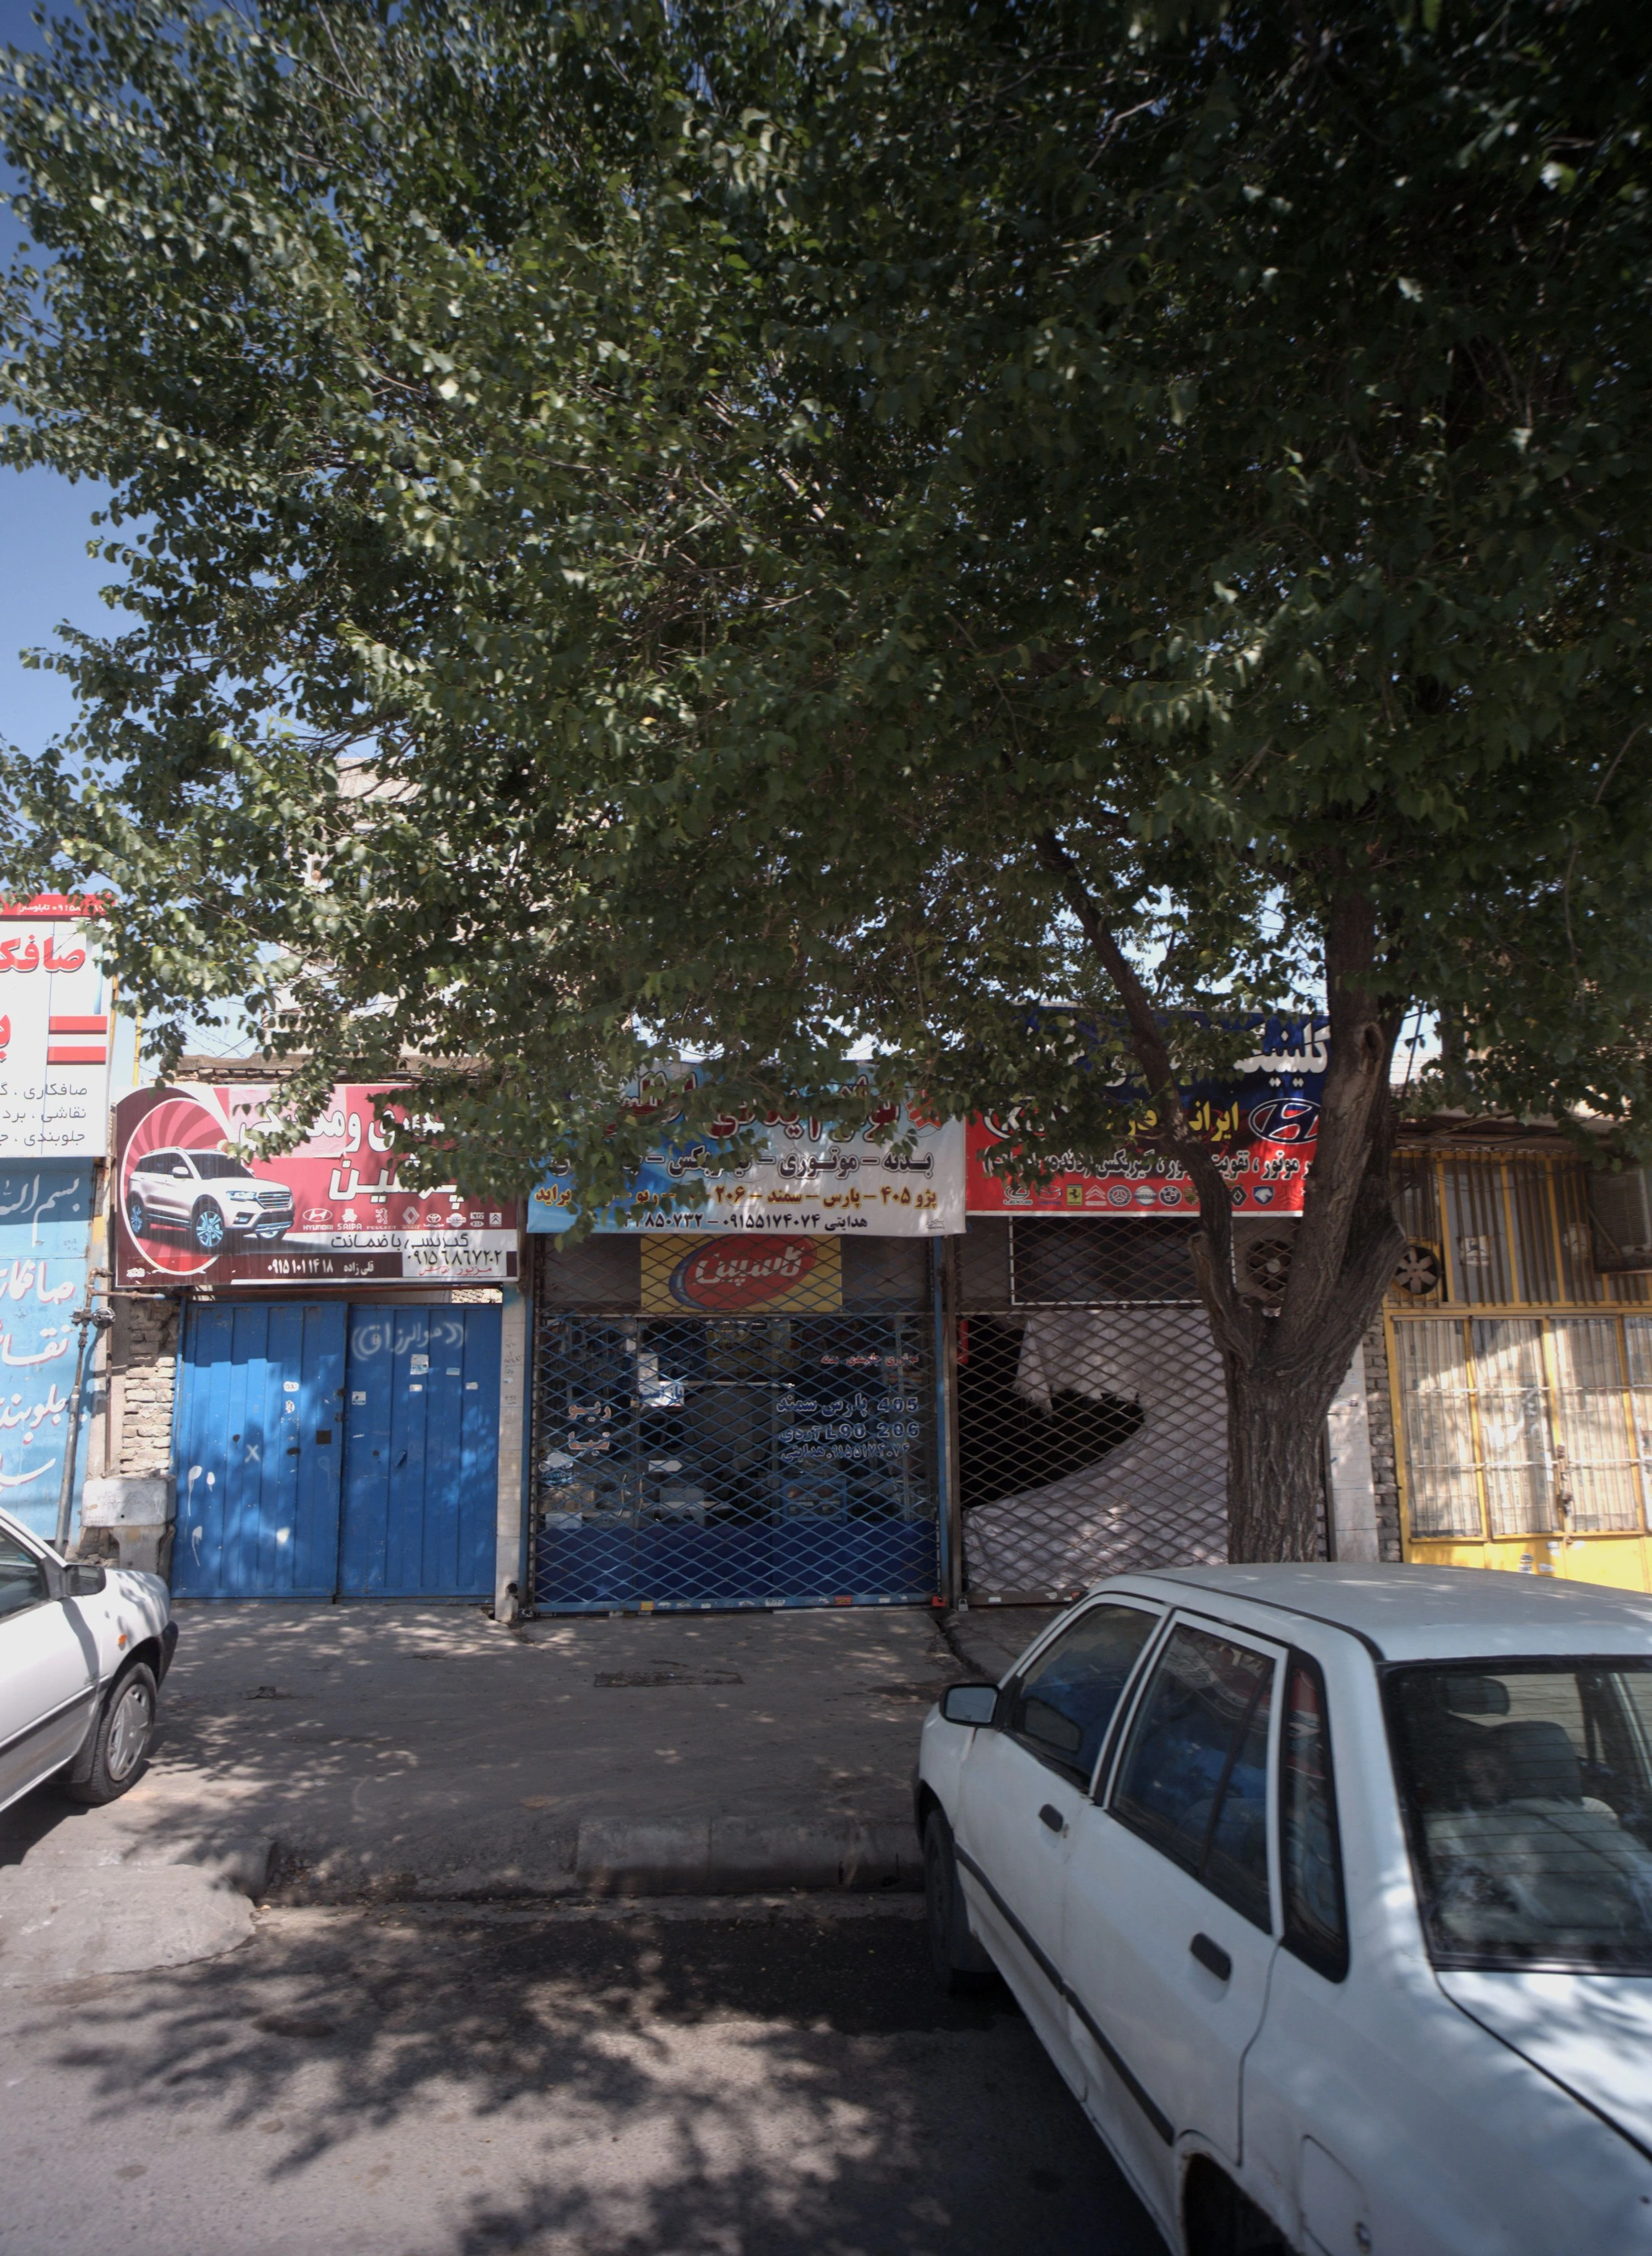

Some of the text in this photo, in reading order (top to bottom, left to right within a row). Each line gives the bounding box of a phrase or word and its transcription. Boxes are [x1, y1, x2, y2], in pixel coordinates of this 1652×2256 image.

[24, 1083, 88, 1099] صافکاری
[41, 1107, 86, 1122] نقاشی
[24, 1130, 85, 1146] جلوبندی
[778, 1146, 860, 1180] موتوری
[1260, 1149, 1300, 1180] موتور
[715, 1185, 746, 1205] ۲۰۶
[767, 1188, 802, 1204] سمند
[824, 1187, 860, 1209] پارس
[881, 1186, 911, 1205] ۴۰۵
[915, 1188, 937, 1208] پژو
[825, 1216, 868, 1230] هدایتی
[877, 1396, 919, 1413] 405
[825, 1422, 866, 1439] L90
[877, 1422, 920, 1438] 206
